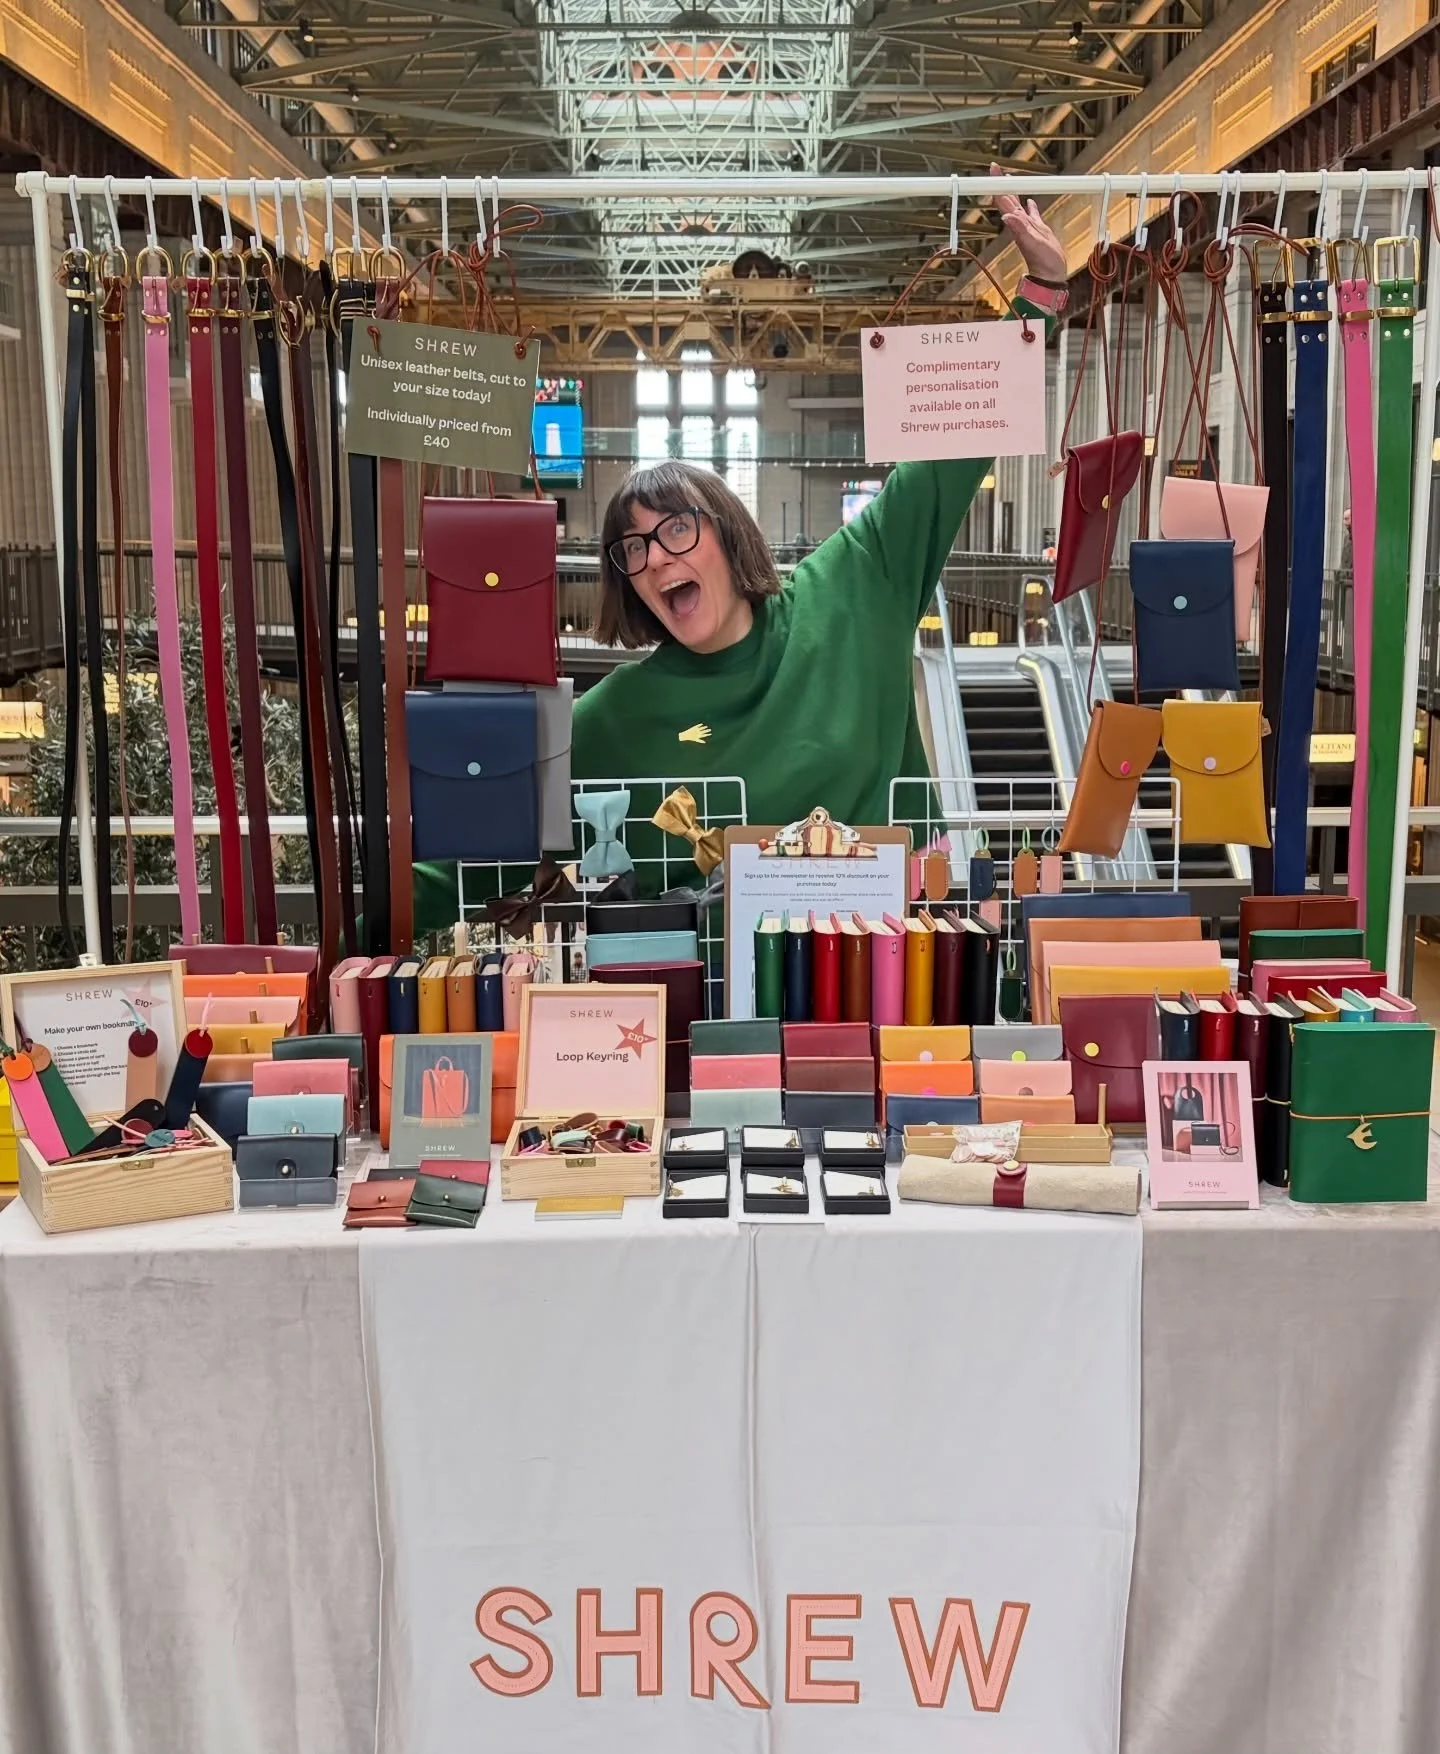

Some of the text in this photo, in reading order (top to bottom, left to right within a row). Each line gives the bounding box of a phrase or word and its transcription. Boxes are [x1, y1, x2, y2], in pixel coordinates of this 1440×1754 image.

[921, 331, 980, 345] SHREW
[415, 337, 477, 356] SHREW
[361, 354, 527, 387] Unisex leather belts, cut to
[906, 360, 1001, 375] Complimentary
[393, 381, 491, 404] your size today!
[906, 379, 999, 396] personalisation
[909, 398, 996, 413] available on all
[367, 406, 512, 437] Individually priced from
[900, 418, 1009, 433] Shrew purchases.
[423, 435, 450, 449] £40
[66, 989, 113, 1002] SHREW
[570, 1009, 614, 1018] SHREW
[44, 1026, 65, 1035] Make
[66, 1025, 85, 1034] your
[103, 1020, 138, 1030] bookmar
[556, 1051, 630, 1063] Loop Keyring
[425, 1144, 456, 1152] SHREW
[470, 1586, 1030, 1714] SHREW
